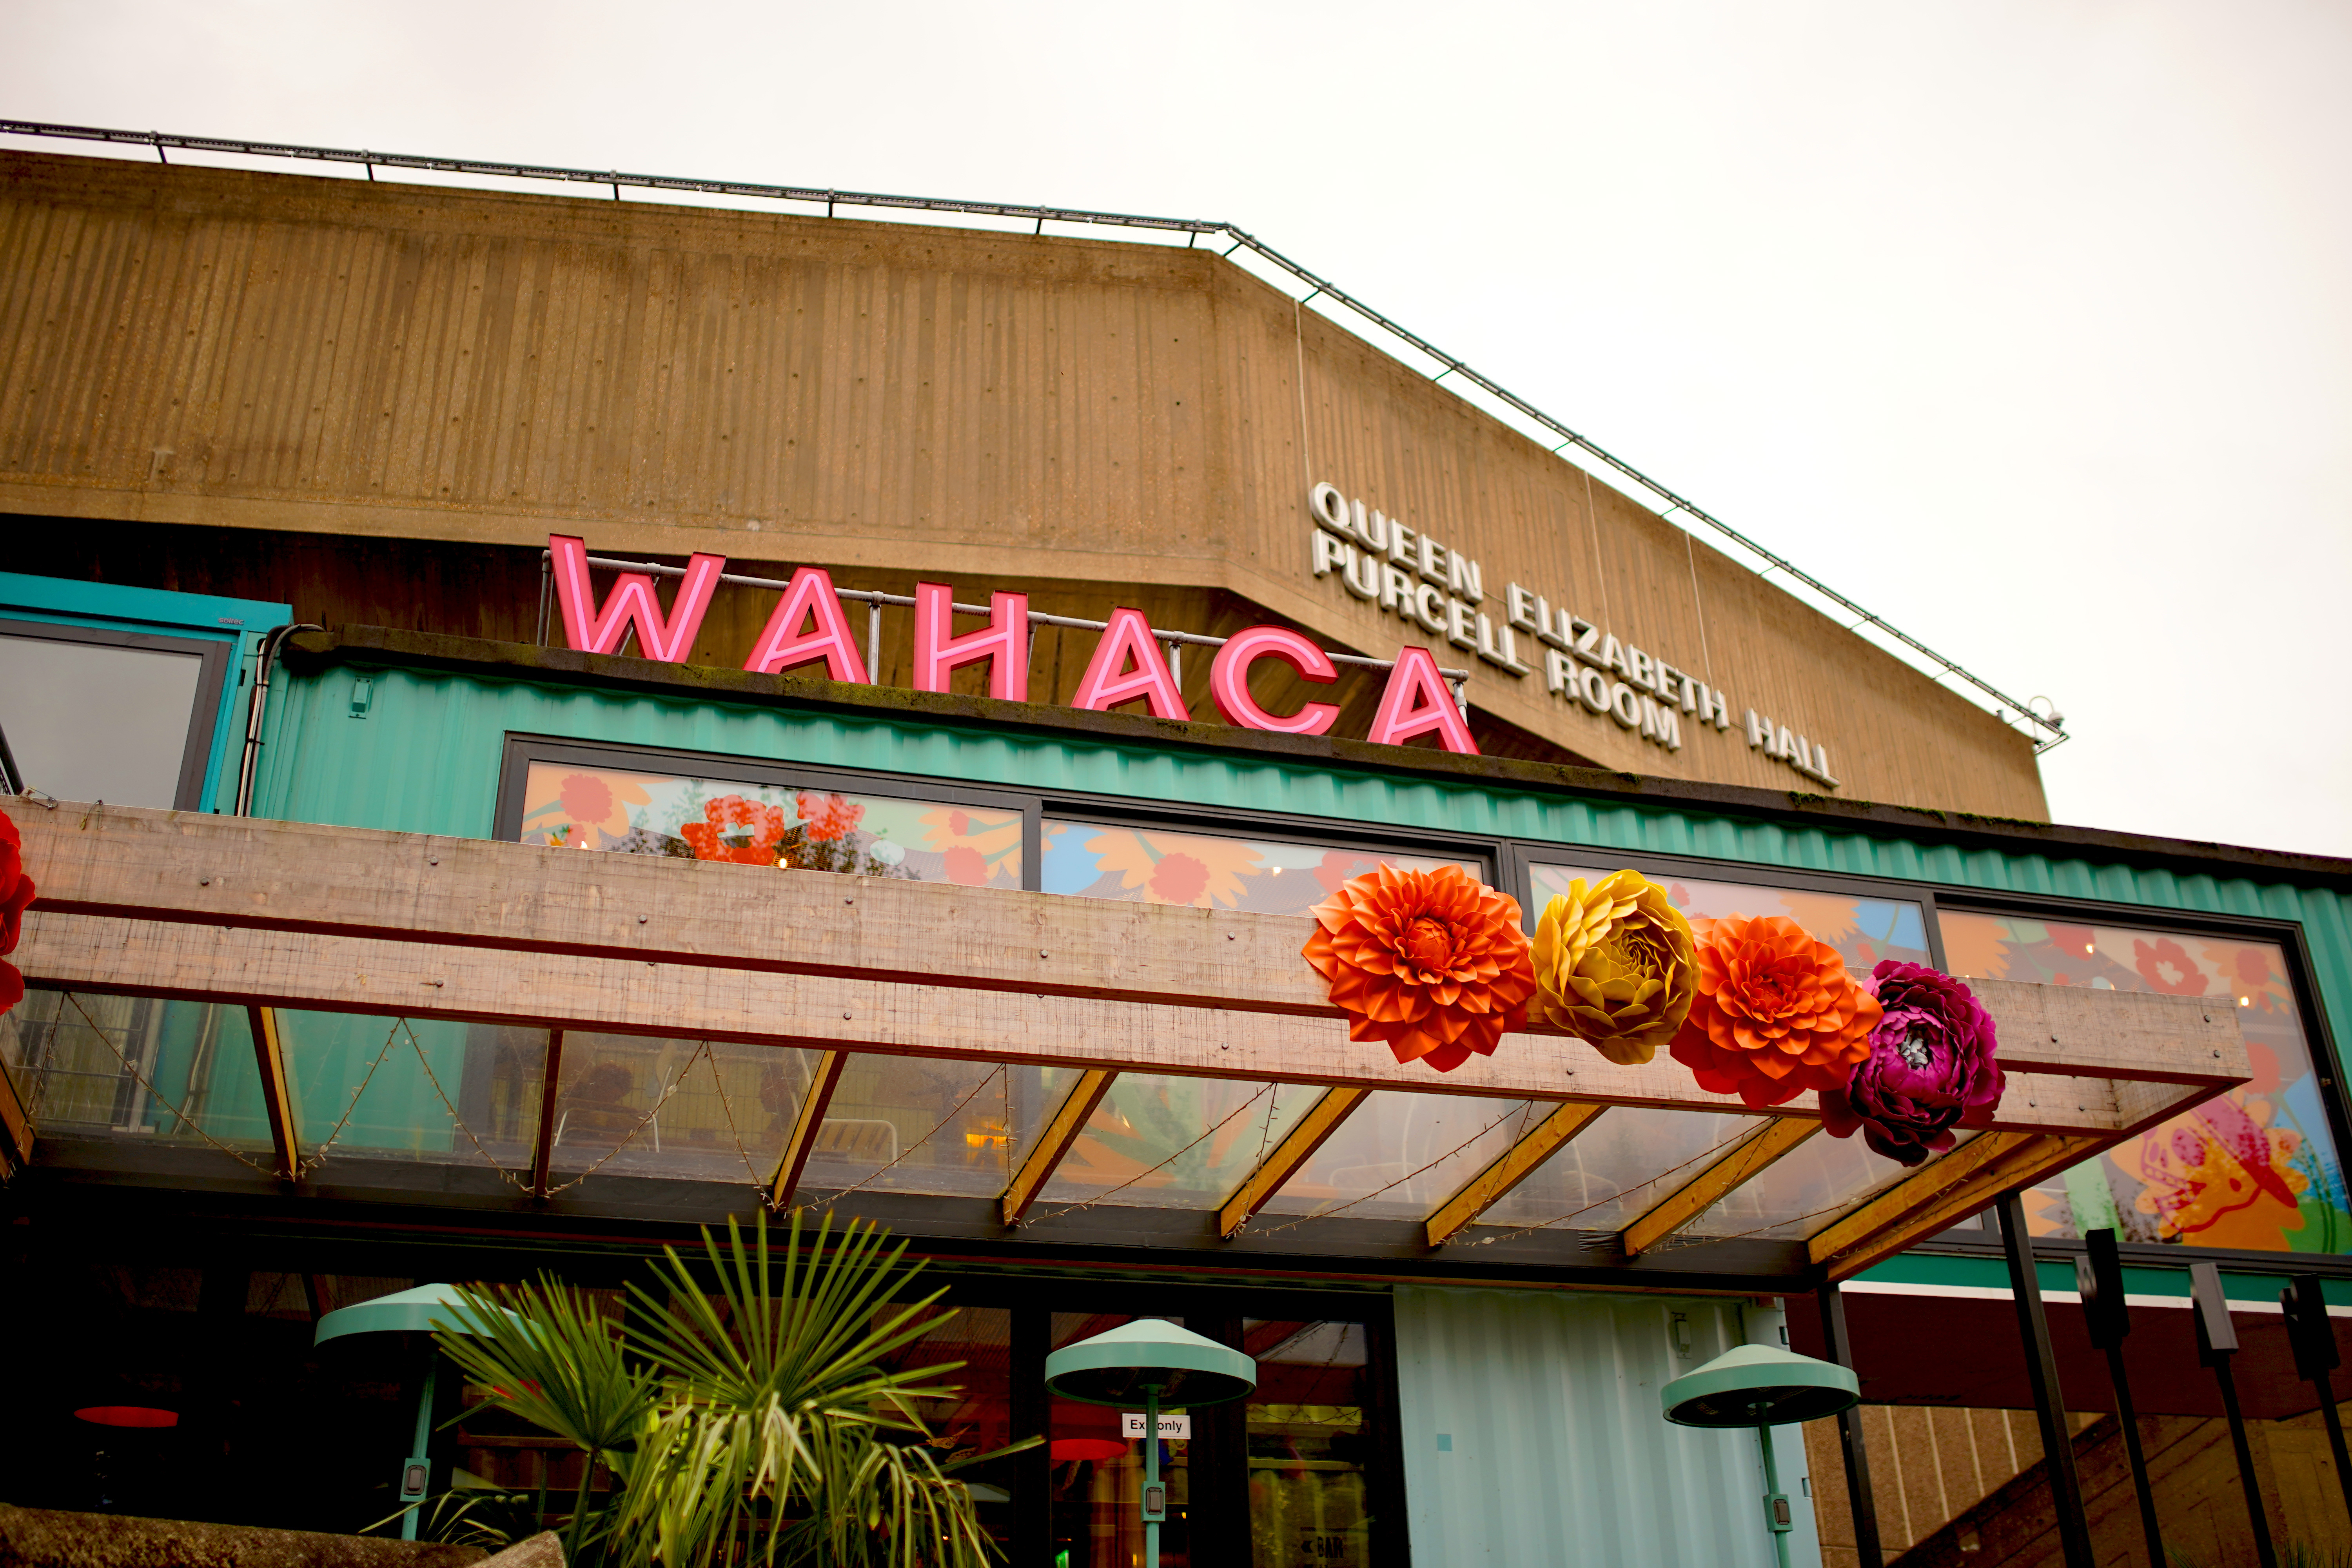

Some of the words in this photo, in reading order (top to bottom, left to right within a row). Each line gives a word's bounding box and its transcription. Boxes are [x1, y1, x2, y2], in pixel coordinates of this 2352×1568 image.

[549, 533, 1480, 755] WAHACA
[1310, 481, 1483, 604] QUEEN
[1506, 581, 1730, 731] ELIZABETH
[1745, 708, 1840, 787] HALL
[1312, 528, 1530, 677] PURCELL
[1545, 648, 1682, 751] ROOM
[1158, 1421, 1182, 1433] only
[1318, 1536, 1344, 1559] BAR
